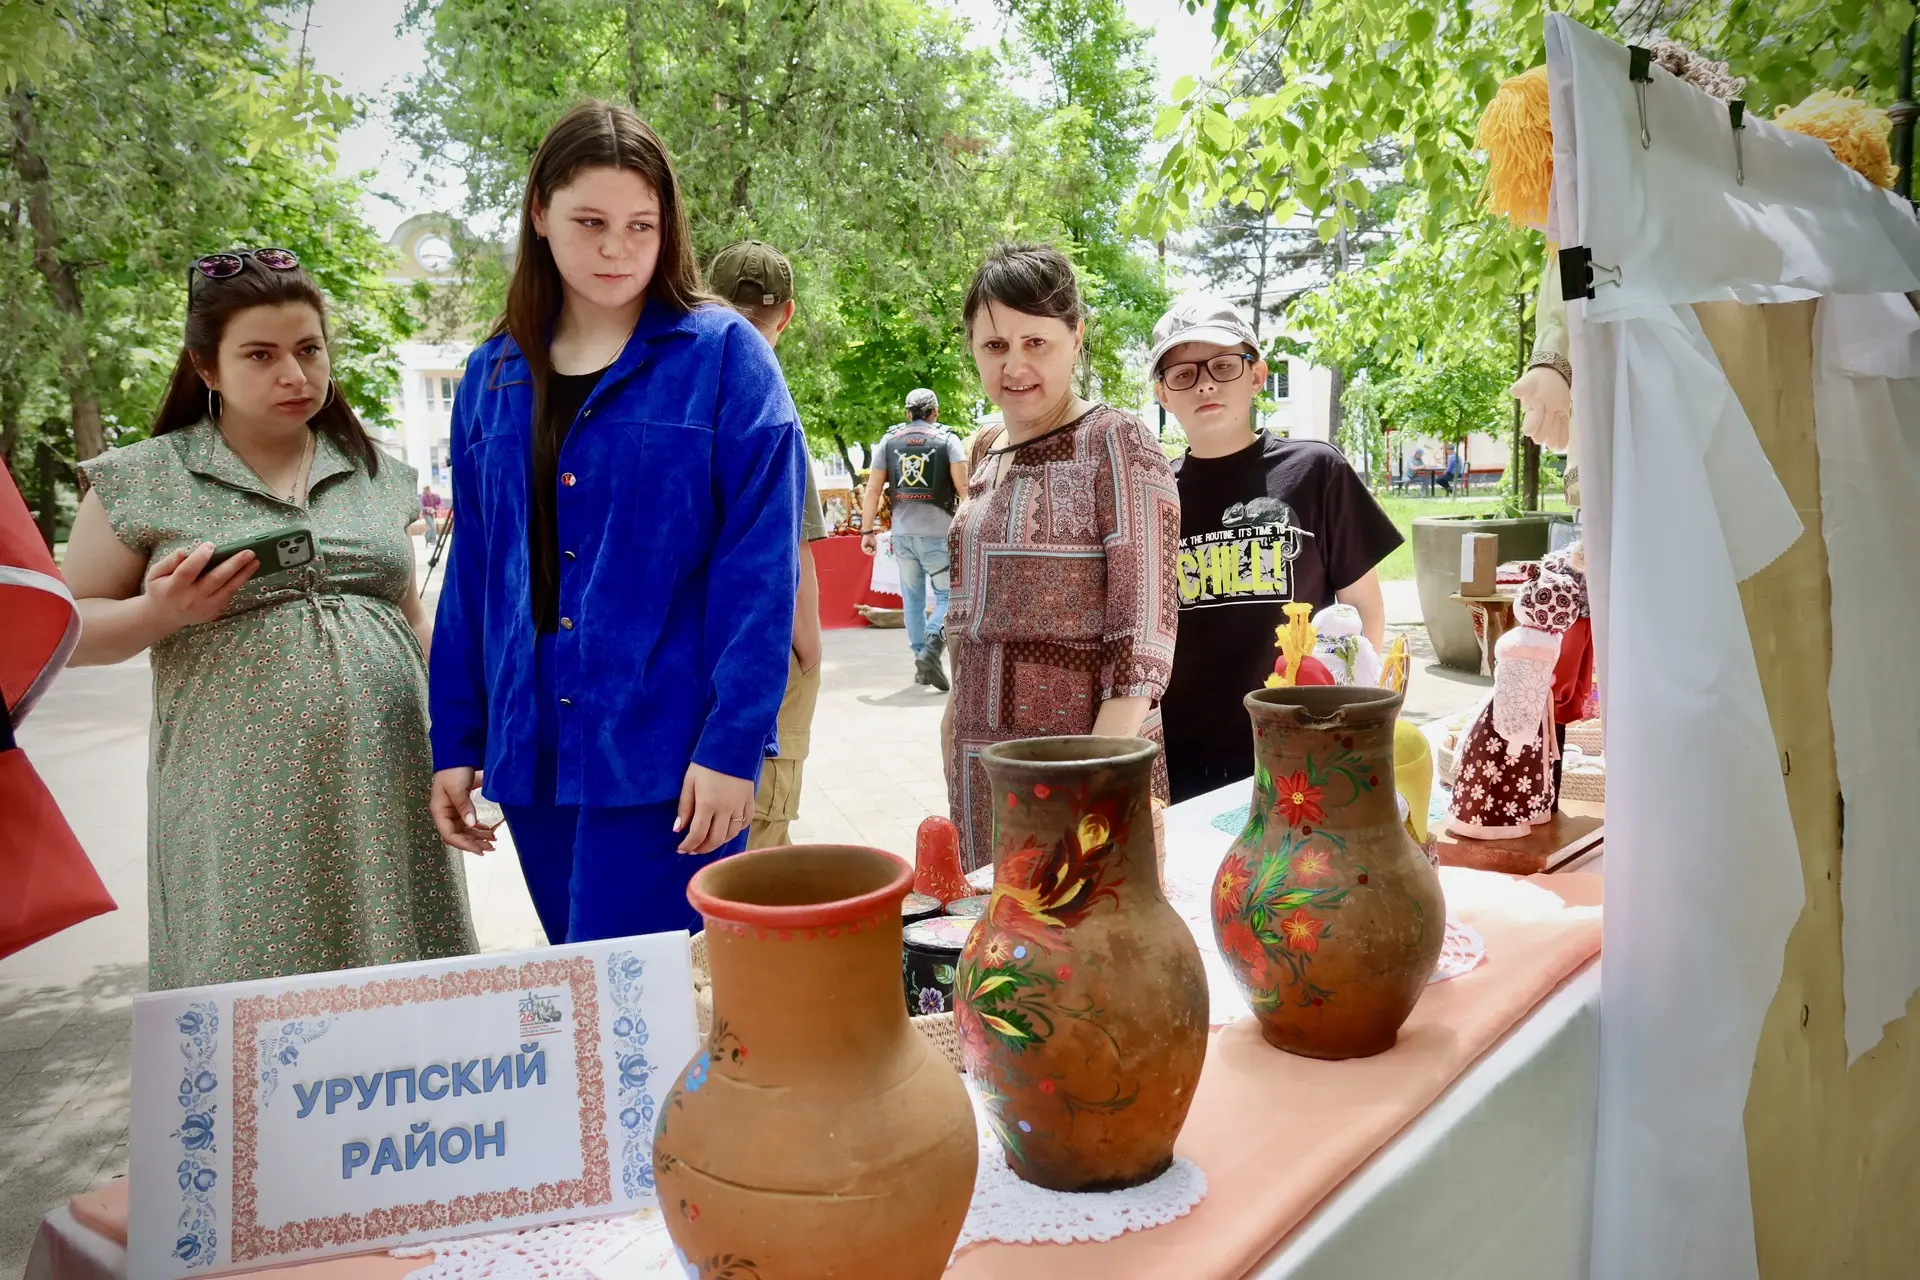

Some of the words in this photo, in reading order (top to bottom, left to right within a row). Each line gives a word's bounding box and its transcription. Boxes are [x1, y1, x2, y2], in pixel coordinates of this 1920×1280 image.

[1179, 538, 1188, 547] AK
[1190, 534, 1204, 545] THE
[1238, 527, 1252, 538] IT'S
[1252, 525, 1273, 536] TIME
[1275, 525, 1286, 535] TO
[1177, 540, 1283, 599] CHILL!
[518, 1001, 533, 1013] 20
[519, 1012, 534, 1023] 26
[293, 1042, 547, 1119] УРУПСКИЙ
[342, 1120, 506, 1180] РАЙОН
